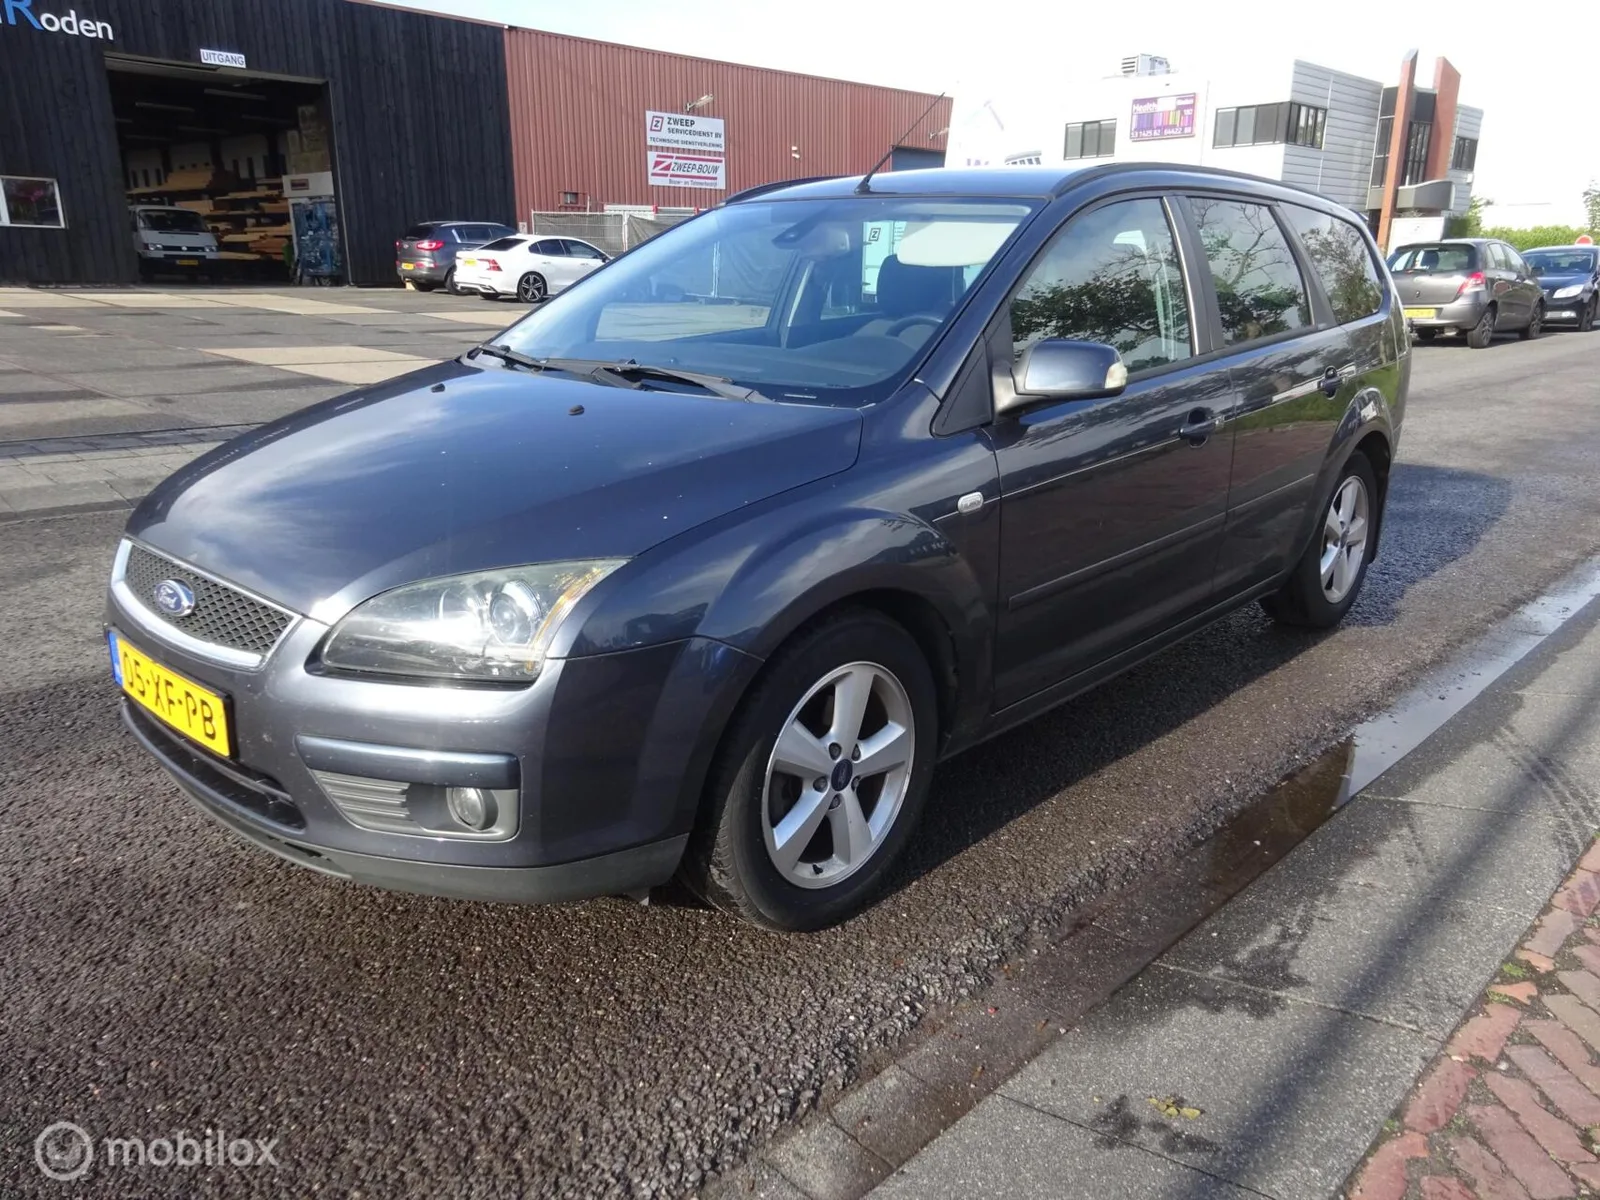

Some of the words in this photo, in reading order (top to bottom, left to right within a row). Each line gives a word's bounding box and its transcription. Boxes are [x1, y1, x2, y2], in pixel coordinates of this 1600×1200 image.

[202, 51, 245, 66] UITGANG
[654, 120, 660, 128] Z
[667, 117, 695, 128] ZWEEP
[667, 128, 714, 138] SERVICEDIENST
[649, 137, 680, 145] TECHNISCHE
[680, 140, 723, 148] DIENSTVERLENING
[671, 162, 720, 174] ZWEEP-BOUW
[158, 585, 178, 609] Ford
[123, 651, 216, 741] 05-XF-PB
